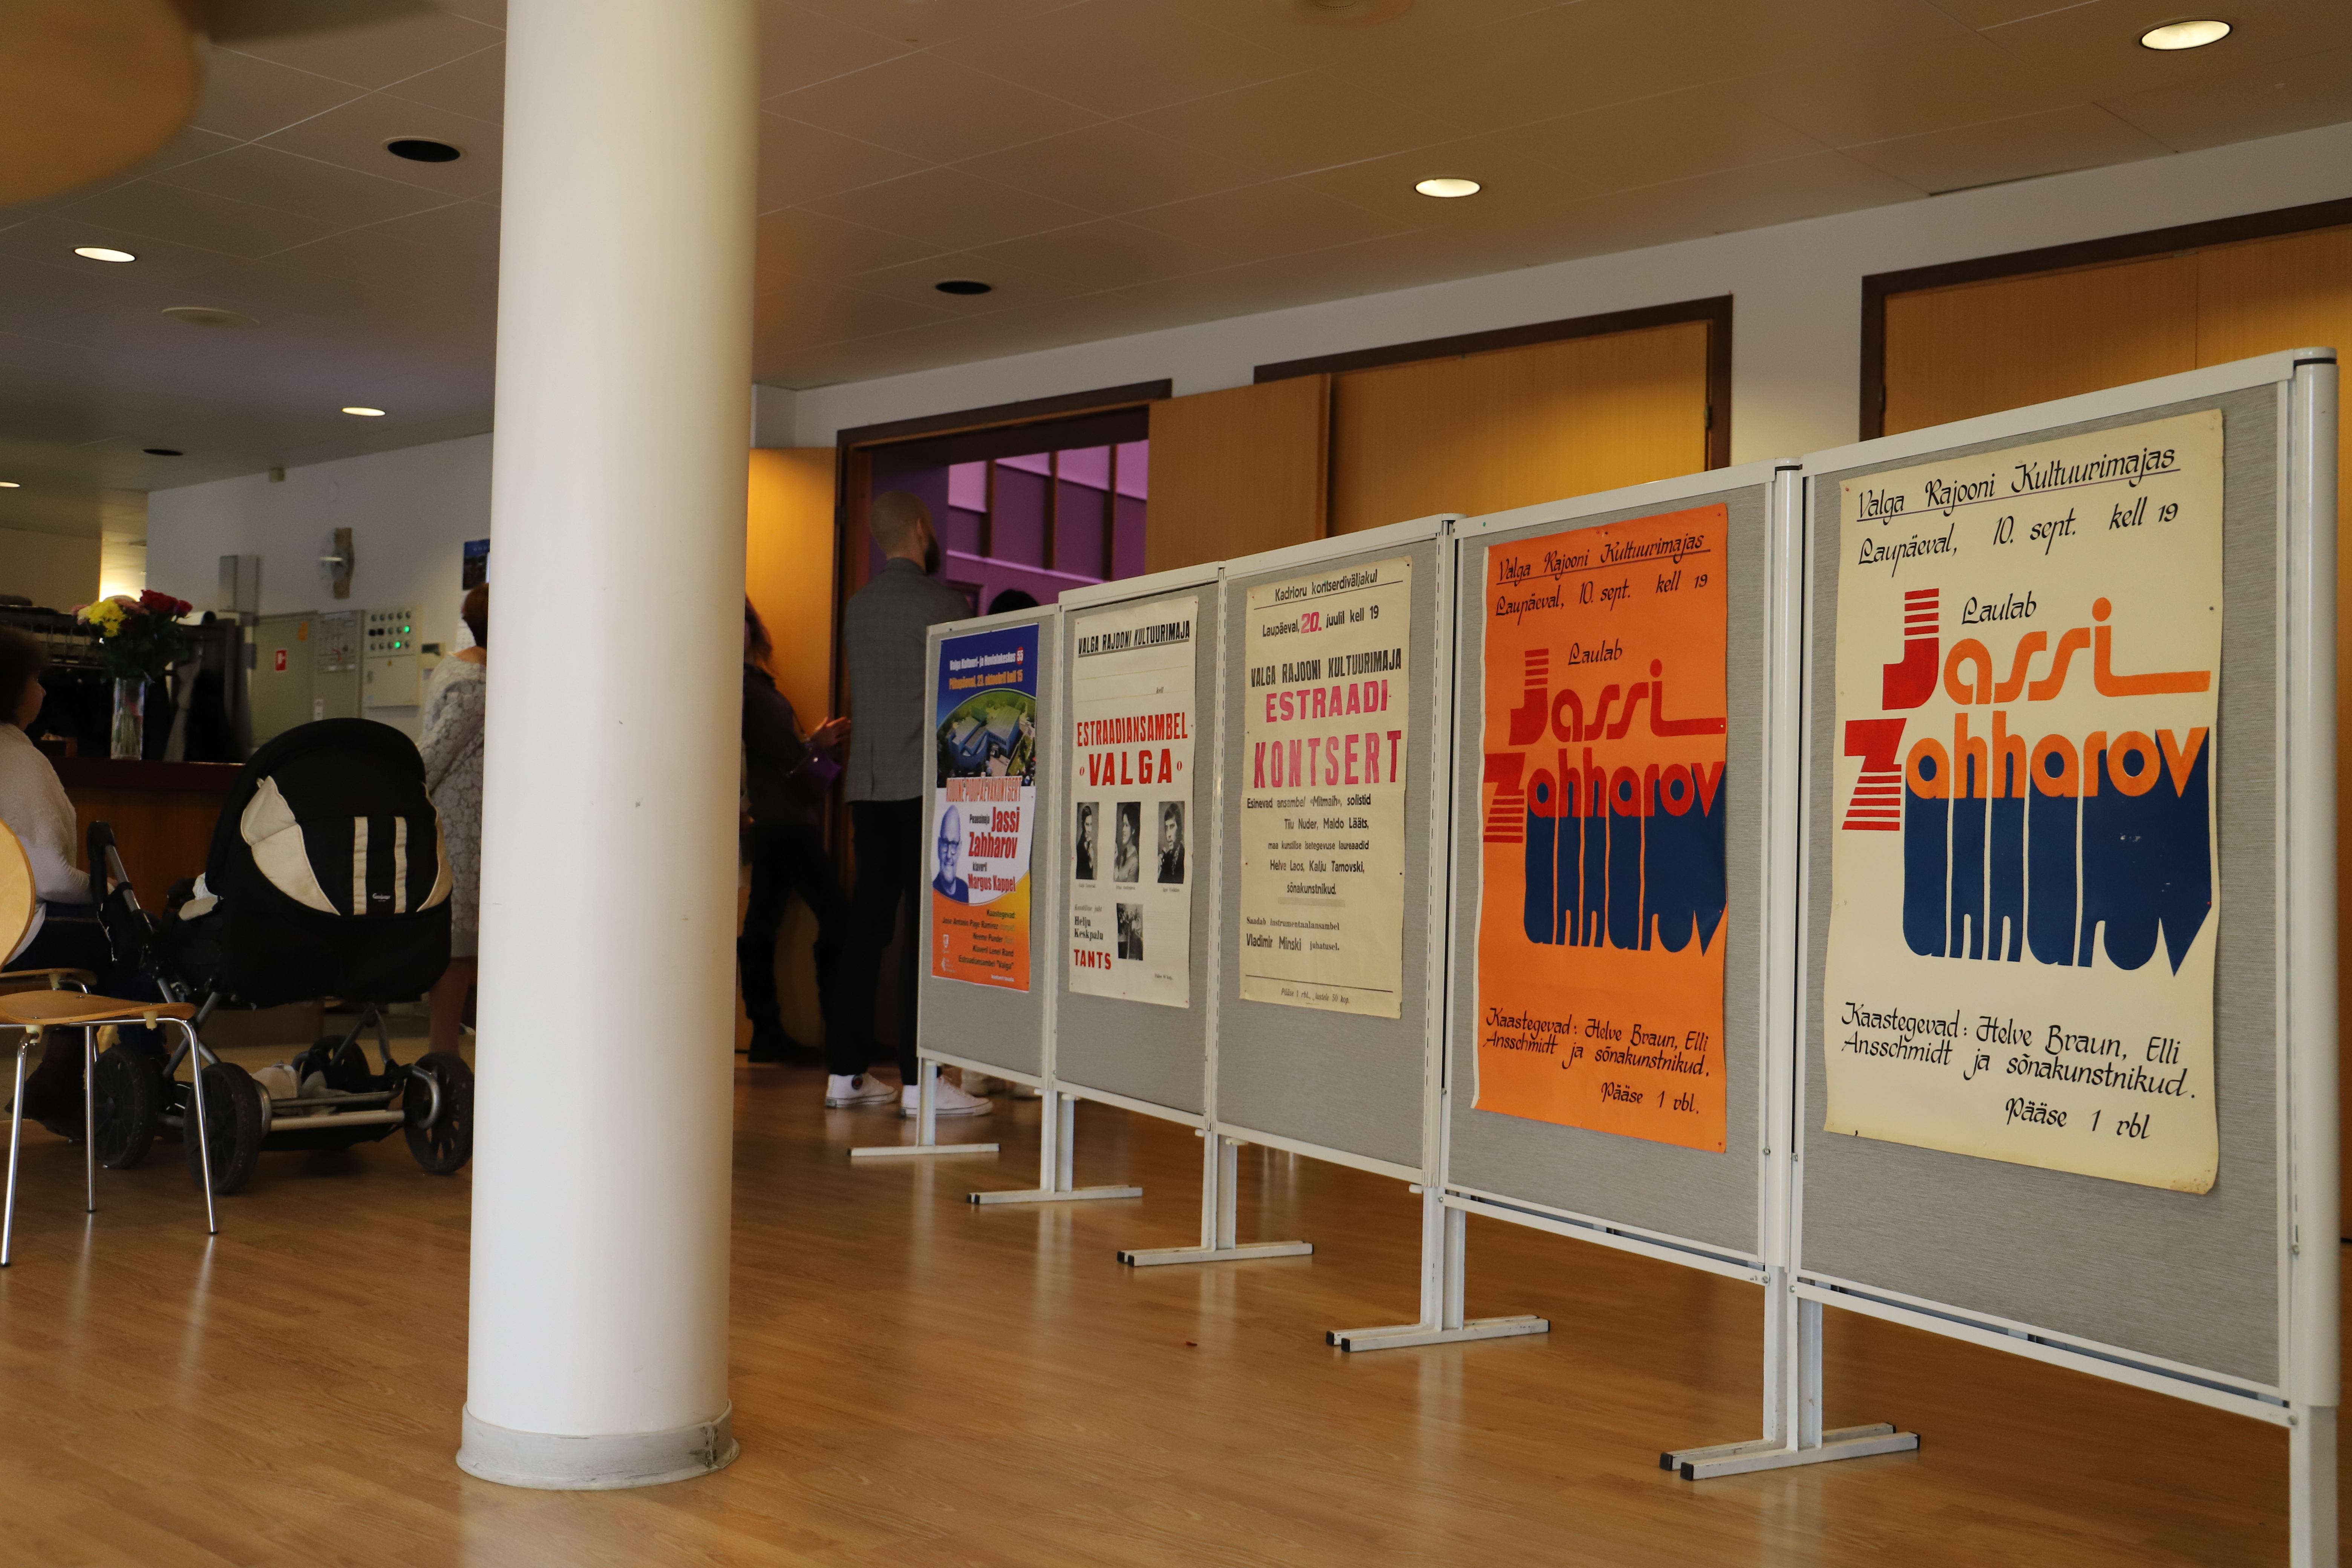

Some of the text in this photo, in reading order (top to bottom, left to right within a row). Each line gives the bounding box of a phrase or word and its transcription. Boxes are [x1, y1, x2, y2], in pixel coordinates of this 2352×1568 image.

[1857, 447, 2175, 525] Valga Rajooni Kultuurimajas
[1858, 496, 2179, 578] Laupäeval, 10. sept. kell 19
[1499, 533, 1705, 586] Valga Rajooni Kultuurimajas
[1275, 569, 1377, 602] Kadrioru kontserdiväljakul
[1496, 570, 1707, 626] Laupäeval, 10. sept. kell 19
[1262, 605, 1379, 637] Laupäeval, 20. juulil kell 19
[1962, 590, 2037, 625] Laulab
[1079, 620, 1190, 655] VALGA RAJOONI KULTUURIMAJA
[1568, 638, 1623, 666] Laulab
[1882, 588, 2210, 710] Jassi
[1017, 669, 1023, 682] 15
[1251, 648, 1401, 688] VALGA RAJOONI KULTUURIMAJA
[1508, 648, 1726, 746] Jassi
[1077, 712, 1188, 747] ESTRAADIANSAMBEL
[1089, 749, 1172, 786] VALGA
[1254, 730, 1401, 789] KONTSERT
[1841, 711, 2210, 831] Zahharov
[1247, 798, 1273, 809] Esinevad
[1277, 796, 1306, 808] ansambel
[1347, 793, 1371, 806] solistid
[1483, 747, 1726, 843] Zahharov
[991, 806, 1020, 833] Jassi
[1298, 818, 1318, 831] Nuder,
[1323, 818, 1344, 829] Maido
[1349, 817, 1369, 829] Lääts,
[968, 831, 1018, 859] Zahharov
[1305, 841, 1335, 851] isetegevuse
[1338, 840, 1369, 850] laureaadid
[968, 873, 1016, 893] Margus Kappel
[1270, 859, 1364, 874] Helve Laos, Kalju Tarnovski,
[1287, 882, 1336, 894] sõnakunstnikud.
[1074, 928, 1103, 941] Keskpalu
[1075, 916, 1091, 928] Helju
[1246, 917, 1340, 930] Saadab instrumentaalansambel
[1246, 933, 1340, 951] Vladimir Minski juhatusel.
[1074, 949, 1112, 970] TANTS
[1332, 994, 1338, 1002] 50
[1340, 996, 1350, 1006] kop.
[1487, 1008, 1709, 1052] Kaastegevad: Helve Braun, Elli
[1841, 1001, 2180, 1065] Kaastegevad: Helve Braun, Elli
[1483, 1031, 1709, 1076] Ansschmidt ja sõnakunstnikud.
[1841, 1031, 2196, 1099] Ansschmidt ja sõnakunstnikud.
[1601, 1082, 1699, 1113] Pääse 1 rbl.
[2005, 1097, 2150, 1139] Pääse 1 rbl
